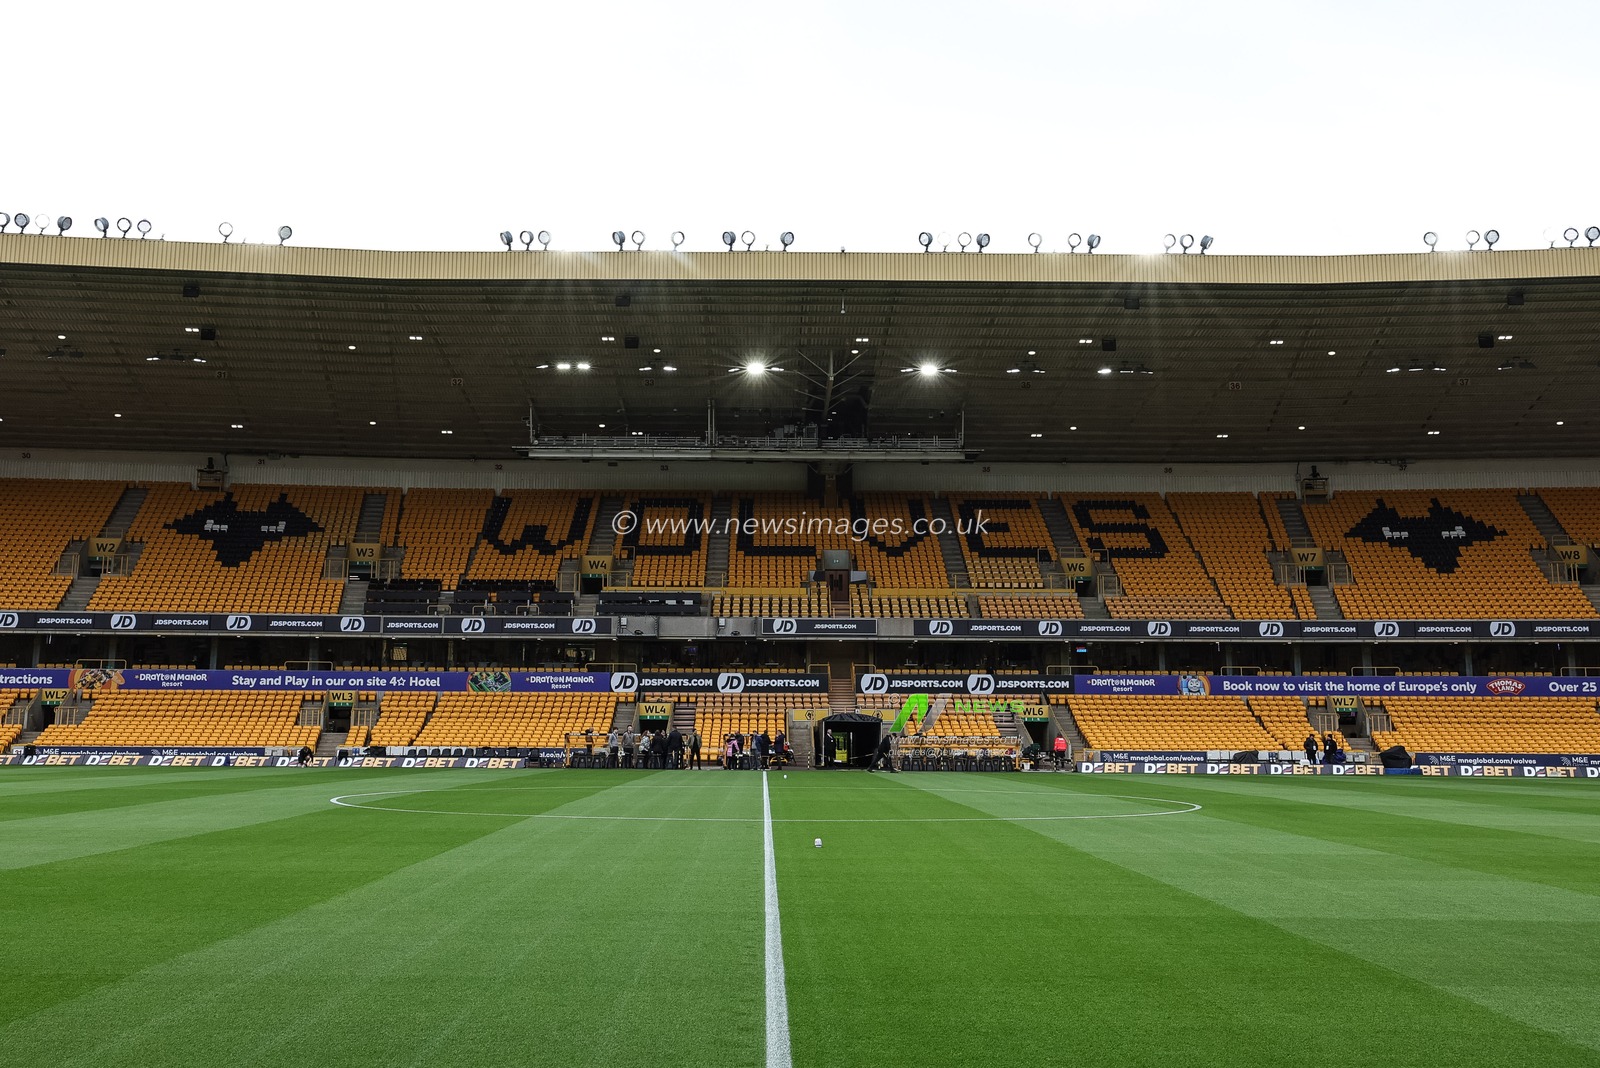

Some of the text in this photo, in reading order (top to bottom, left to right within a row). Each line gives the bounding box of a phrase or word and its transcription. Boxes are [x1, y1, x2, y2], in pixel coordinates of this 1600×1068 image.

[96, 543, 116, 552] W2
[356, 548, 374, 557] W3
[1298, 552, 1316, 562] W7
[1560, 550, 1580, 560] W8
[588, 560, 606, 570] W4
[1067, 562, 1085, 572] W6
[232, 675, 257, 688] Stay
[259, 675, 282, 686] and
[285, 676, 309, 688] Play
[312, 676, 322, 686] in
[366, 677, 387, 686] site
[409, 676, 440, 687] Hotel
[640, 679, 713, 687] JDSPORTS.COM
[746, 679, 819, 687] JDSPORTS.COM
[1489, 680, 1523, 689] THOMAS
[1223, 681, 1252, 691] Book
[1283, 682, 1295, 691] to
[1298, 681, 1322, 691] visit
[1324, 681, 1344, 691] the
[1347, 681, 1380, 692] home
[1383, 681, 1396, 692] of
[1398, 682, 1448, 694] Europe's
[1451, 682, 1477, 694] only
[1548, 682, 1597, 692] Over 25
[45, 690, 67, 699] WL2
[332, 692, 353, 701] WL3
[1333, 698, 1354, 706] WL7
[644, 705, 666, 714] WL4
[1024, 707, 1043, 716] WL6
[85, 755, 144, 765] DEBET
[148, 756, 206, 766] DEBET
[276, 757, 335, 767] DEET
[401, 758, 459, 768] DEBET
[465, 758, 521, 768] DEBET
[1081, 763, 1136, 773] DEBET
[1144, 763, 1198, 774] DEBET
[1207, 764, 1262, 774] DEBET
[1332, 765, 1384, 775] DEBET
[1460, 766, 1515, 776] DEBET
